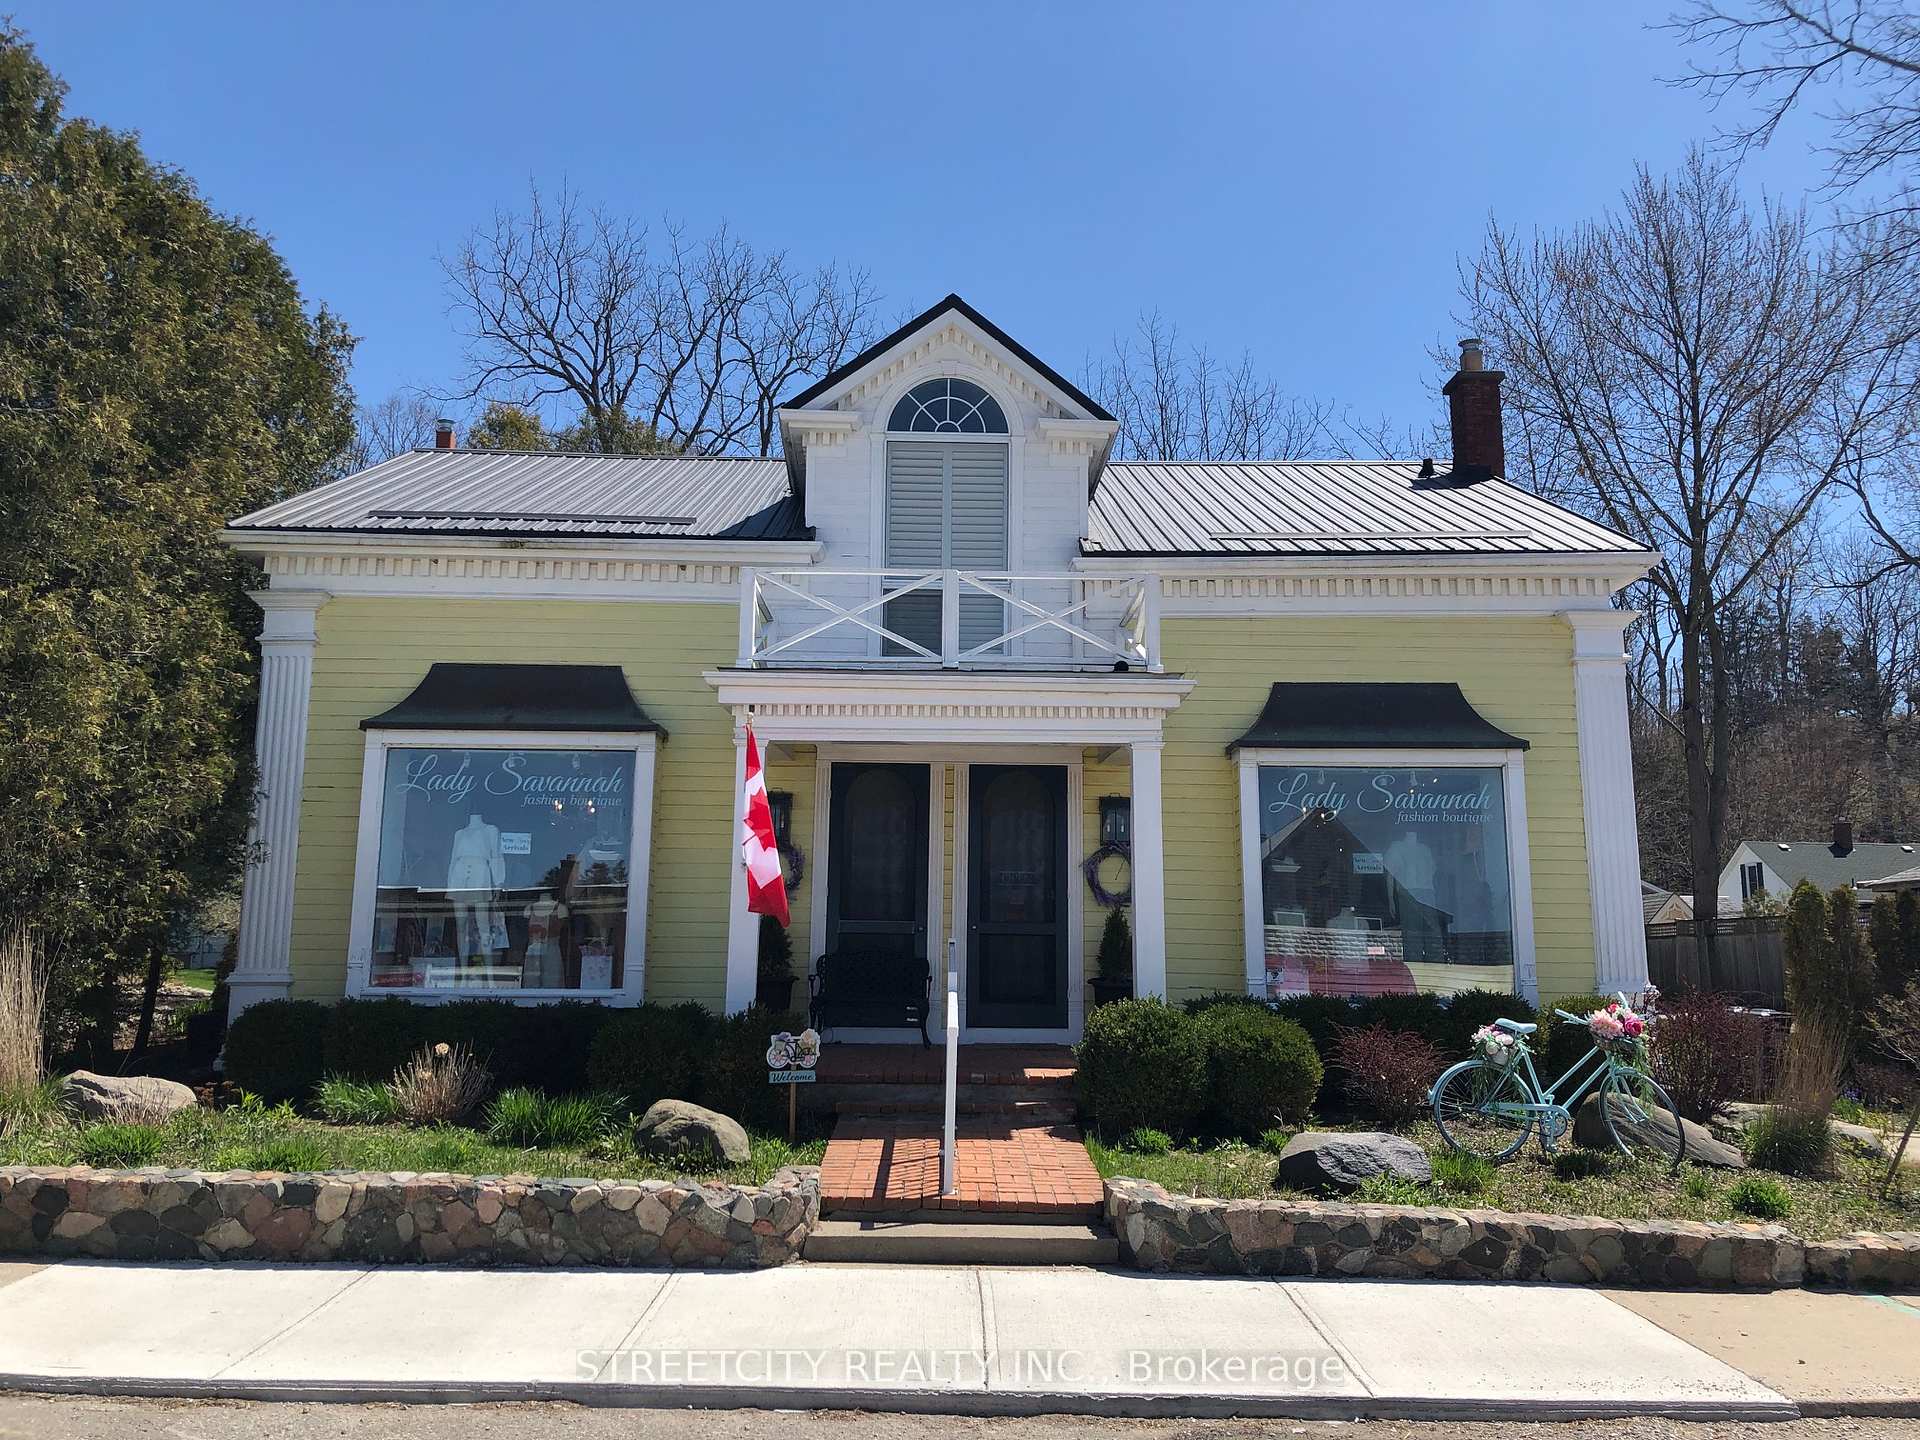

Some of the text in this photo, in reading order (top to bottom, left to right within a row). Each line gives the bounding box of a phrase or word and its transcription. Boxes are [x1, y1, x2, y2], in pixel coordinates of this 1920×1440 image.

[397, 754, 625, 804] Lady Savannah
[521, 793, 565, 808] fashion
[1268, 772, 1490, 822] Lady Savannah
[1395, 811, 1492, 825] fashion boutique
[772, 1072, 813, 1082] Welcome
